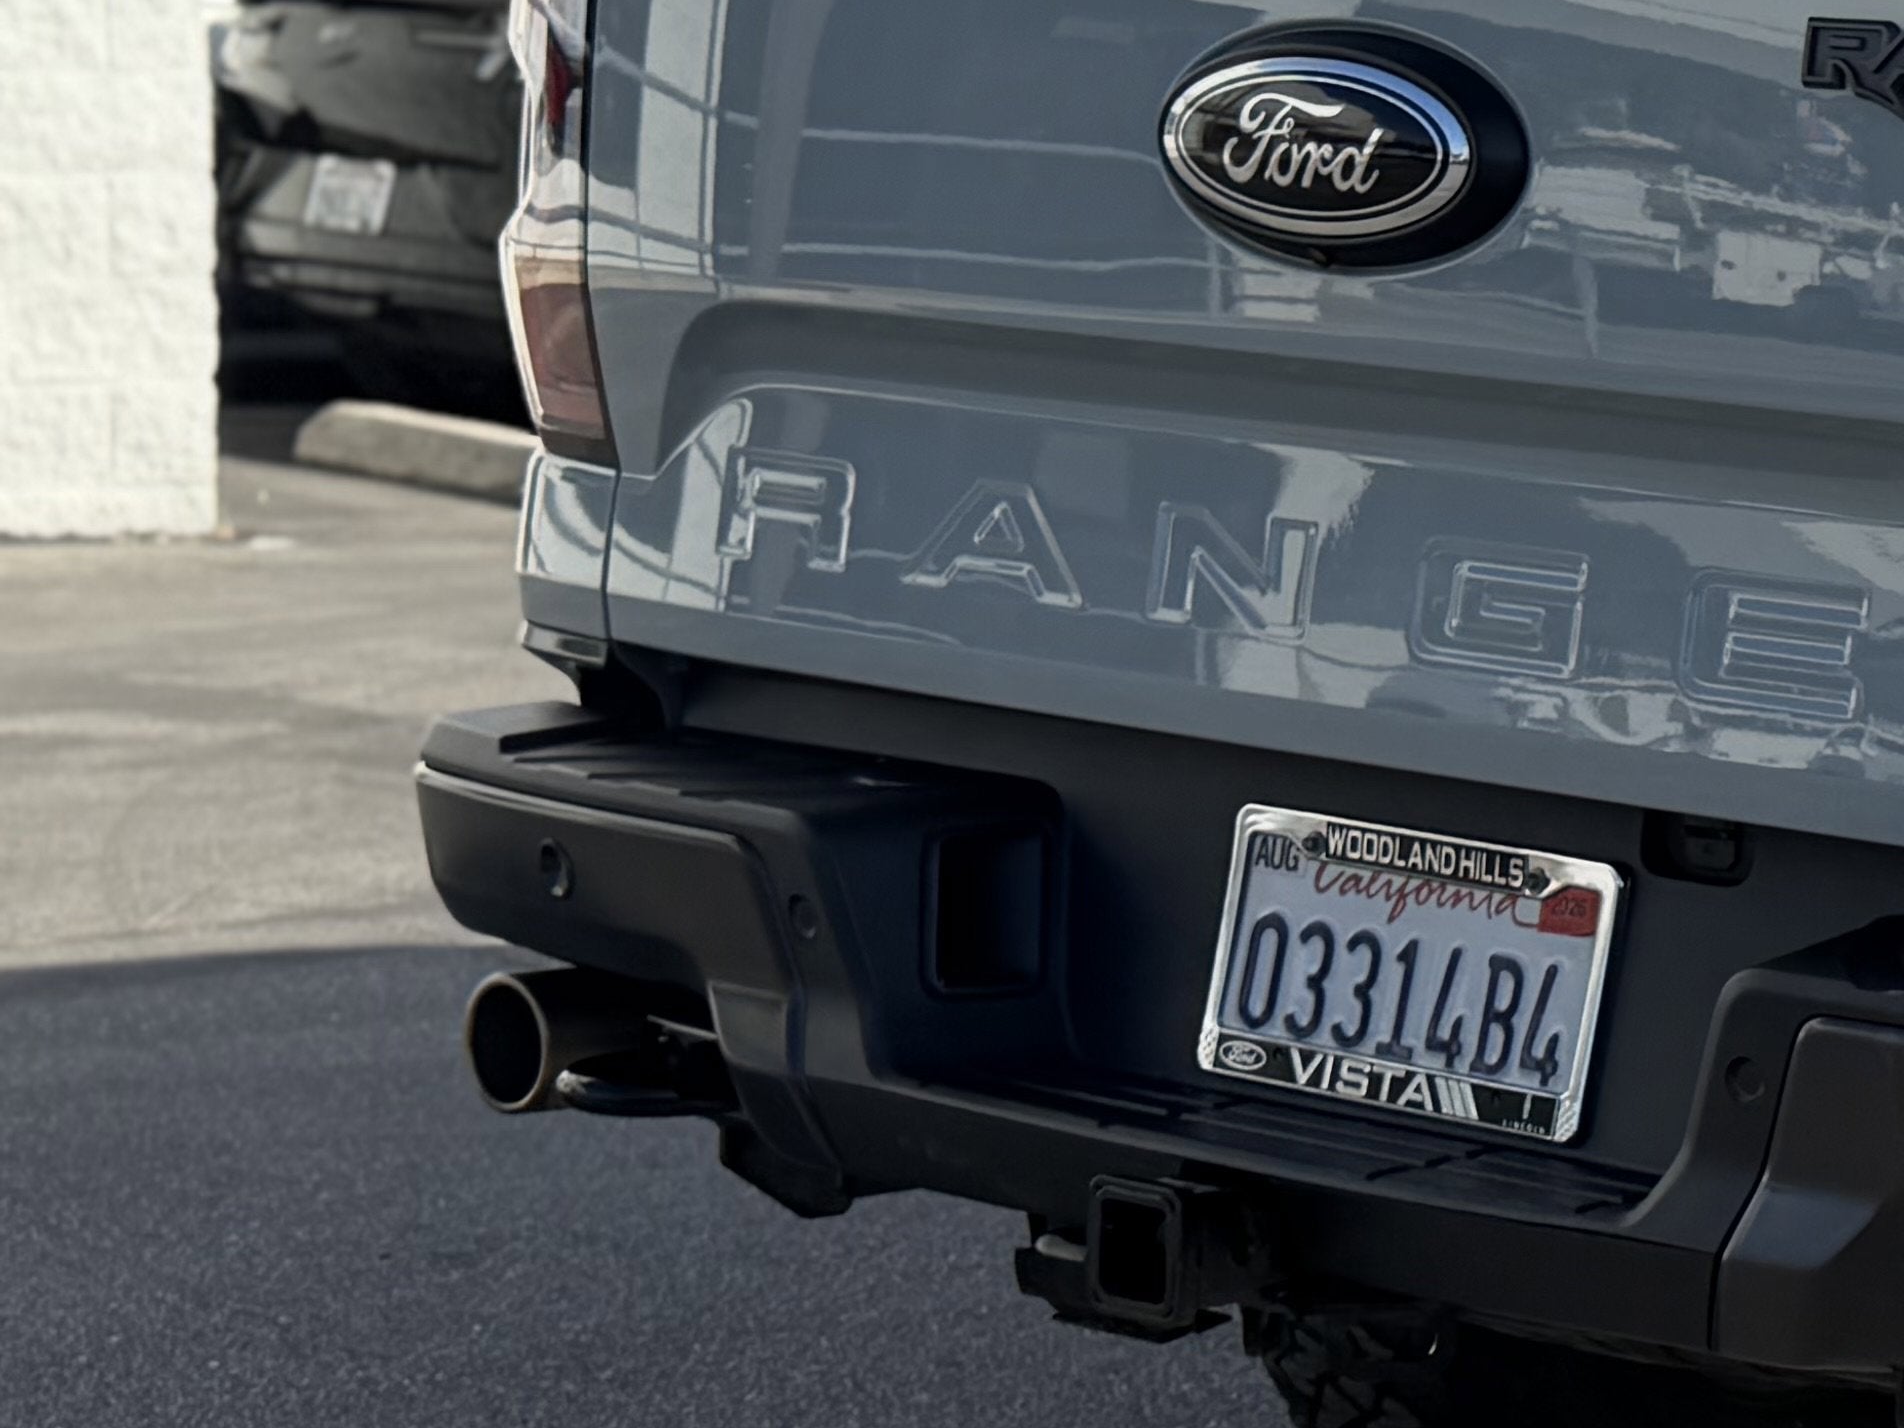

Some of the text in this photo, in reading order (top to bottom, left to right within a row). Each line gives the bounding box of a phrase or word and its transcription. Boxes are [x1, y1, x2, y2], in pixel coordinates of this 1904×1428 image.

[1222, 92, 1386, 194] Ford
[1254, 839, 1300, 873] AUG
[1327, 826, 1525, 888] WOODLAND HILLS
[1313, 862, 1542, 930] California
[1239, 912, 1560, 1087] 03314B4
[1290, 1047, 1435, 1113] VISTA
